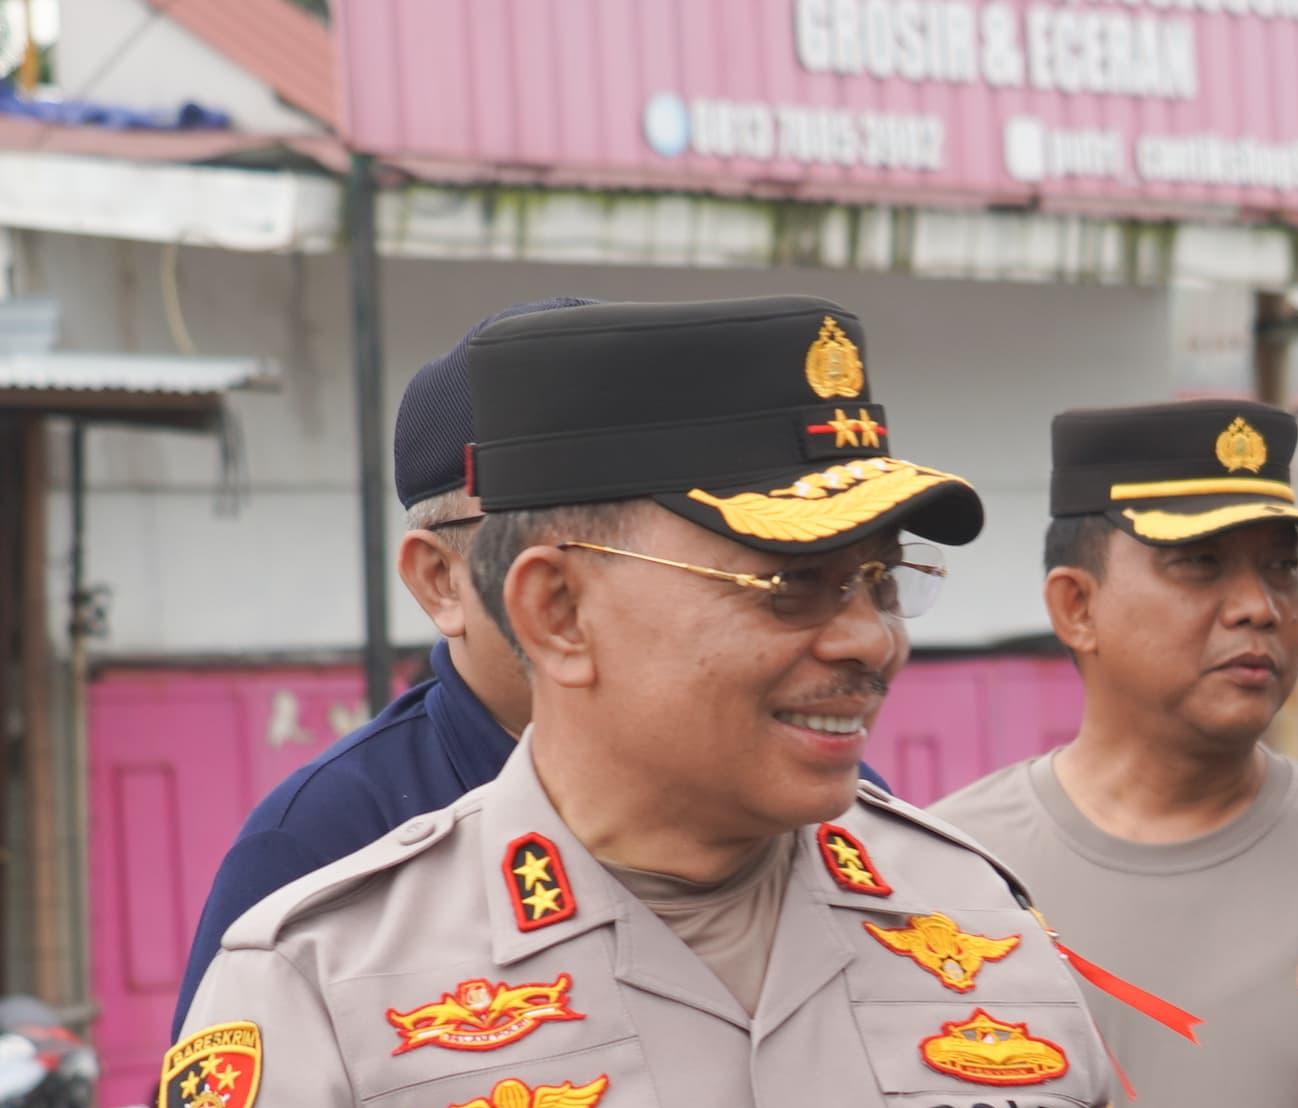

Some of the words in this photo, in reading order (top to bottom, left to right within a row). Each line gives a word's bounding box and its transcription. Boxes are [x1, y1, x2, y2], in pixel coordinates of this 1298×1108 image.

[796, 0, 976, 84] GROSIR
[981, 2, 1023, 87] &
[1026, 8, 1197, 99] ECERAN
[170, 1028, 257, 1069] BARESKRIM
